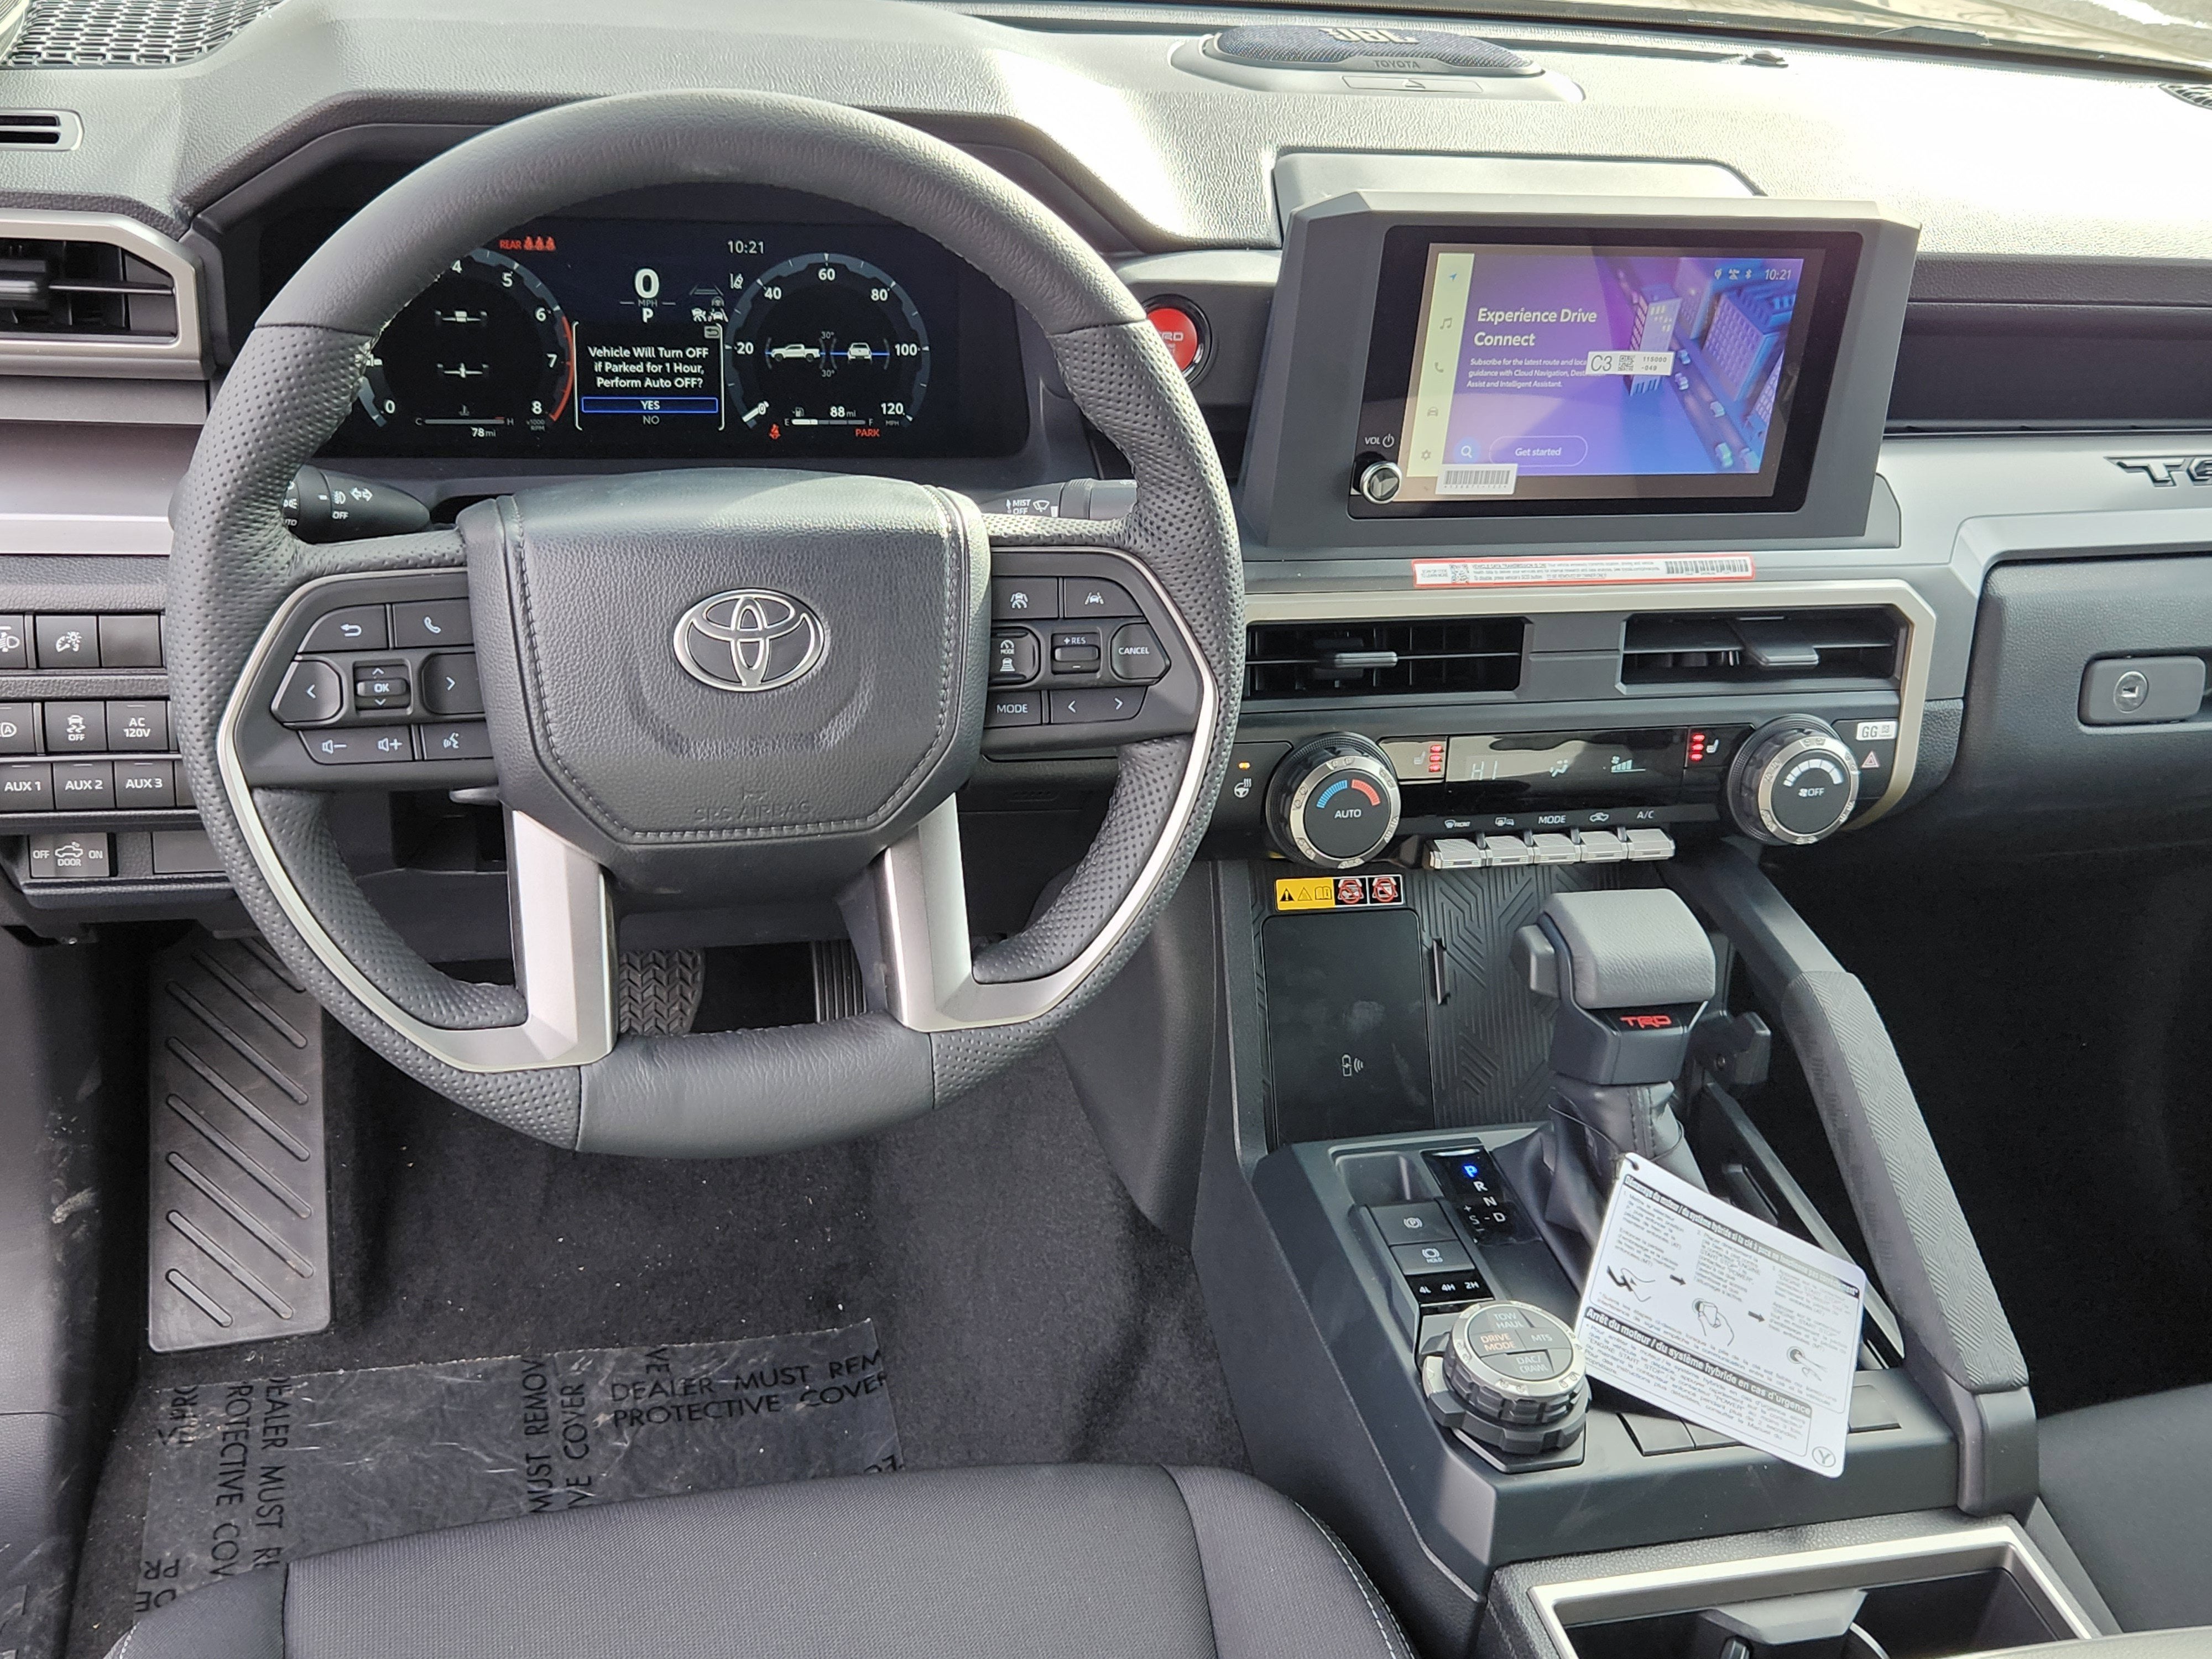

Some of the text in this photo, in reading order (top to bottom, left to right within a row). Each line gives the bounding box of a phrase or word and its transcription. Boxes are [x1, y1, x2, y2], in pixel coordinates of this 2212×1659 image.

[1319, 28, 1420, 44] JBL
[1374, 60, 1420, 70] TOYOTA
[499, 239, 521, 249] REAR
[728, 240, 765, 254] 10:21
[451, 260, 462, 274] 4
[818, 268, 836, 281] 60
[1764, 268, 1792, 281] 10:21
[501, 274, 513, 288] 5
[635, 269, 660, 299] 0
[764, 287, 782, 301] 40
[870, 288, 888, 301] 80
[638, 299, 658, 307] MPH
[535, 307, 547, 321] 6
[641, 308, 654, 323] P
[1477, 307, 1598, 325] Experience Drive
[1474, 332, 1536, 347] Connect
[587, 346, 709, 358] Vehicle Will Turn OFF
[737, 342, 754, 356] 20
[894, 343, 918, 357] 100
[546, 354, 558, 369] 7
[1591, 354, 1613, 372] C3
[594, 361, 705, 375] if Parked for 1 Hour,
[1468, 370, 1498, 378] guidance
[1534, 369, 1569, 379] Navigation,
[596, 376, 704, 388] Perform Auto OFF?
[384, 400, 396, 414] 0
[531, 400, 542, 415] 8
[640, 400, 661, 410] YES
[880, 402, 904, 415] 120
[830, 406, 846, 418] 88
[507, 418, 514, 426] H
[642, 415, 660, 425] NO
[471, 427, 497, 437] 78 mi
[855, 428, 880, 437] PARK
[1364, 436, 1381, 446] VOL
[1515, 447, 1562, 457] Get started
[1012, 498, 1031, 507] MIST
[332, 510, 349, 519] OFF
[1013, 507, 1029, 515] OFF
[1118, 646, 1150, 655] CANCEL
[373, 682, 390, 693] OK
[997, 704, 1028, 714] MODE
[128, 717, 146, 727] AC
[122, 728, 151, 738] 120V
[1861, 726, 1878, 738] GG
[1470, 760, 1499, 780] HI
[4, 781, 41, 791] AUX 1
[65, 779, 103, 791] AUX 2
[126, 778, 163, 790] AUX 3
[1808, 787, 1825, 797] OFF
[1333, 808, 1362, 820] AUTO
[1637, 810, 1655, 820] A/C
[1538, 815, 1567, 825] MODE
[33, 850, 50, 859] OFF
[88, 850, 103, 859] ON
[58, 858, 82, 867] DOOR
[1620, 1015, 1672, 1029] TRD
[1463, 1165, 1479, 1178] P
[1473, 1181, 1488, 1192] R
[1483, 1196, 1498, 1207] N
[1469, 1215, 1480, 1225] S
[1493, 1212, 1506, 1223] D
[1441, 1284, 1456, 1292] 4H
[1464, 1281, 1479, 1290] 2H
[1494, 1313, 1517, 1321] TOW
[1496, 1321, 1524, 1329] HAUL
[1480, 1333, 1512, 1343] DRIVE
[1531, 1334, 1553, 1343] MTS
[1484, 1340, 1516, 1352] MODE
[1515, 1354, 1541, 1364] DAC/
[1585, 1307, 1609, 1326] Arrêt
[1607, 1318, 1620, 1331] du
[1619, 1324, 1651, 1346] moteur
[1655, 1340, 1669, 1354] du
[1667, 1345, 1705, 1371] système
[1703, 1361, 1738, 1386] hybride
[1738, 1379, 1749, 1390] en
[1750, 1384, 1766, 1397] cas
[1766, 1390, 1811, 1418] d'urgence
[1519, 1363, 1548, 1374] CRAWL
[611, 1376, 713, 1402] DEALER
[734, 1365, 810, 1391] MUST
[613, 1394, 781, 1427] PROTECTIVE
[560, 1383, 590, 1459] COVER
[525, 1452, 555, 1513] MUST
[255, 1465, 286, 1529] MUST
